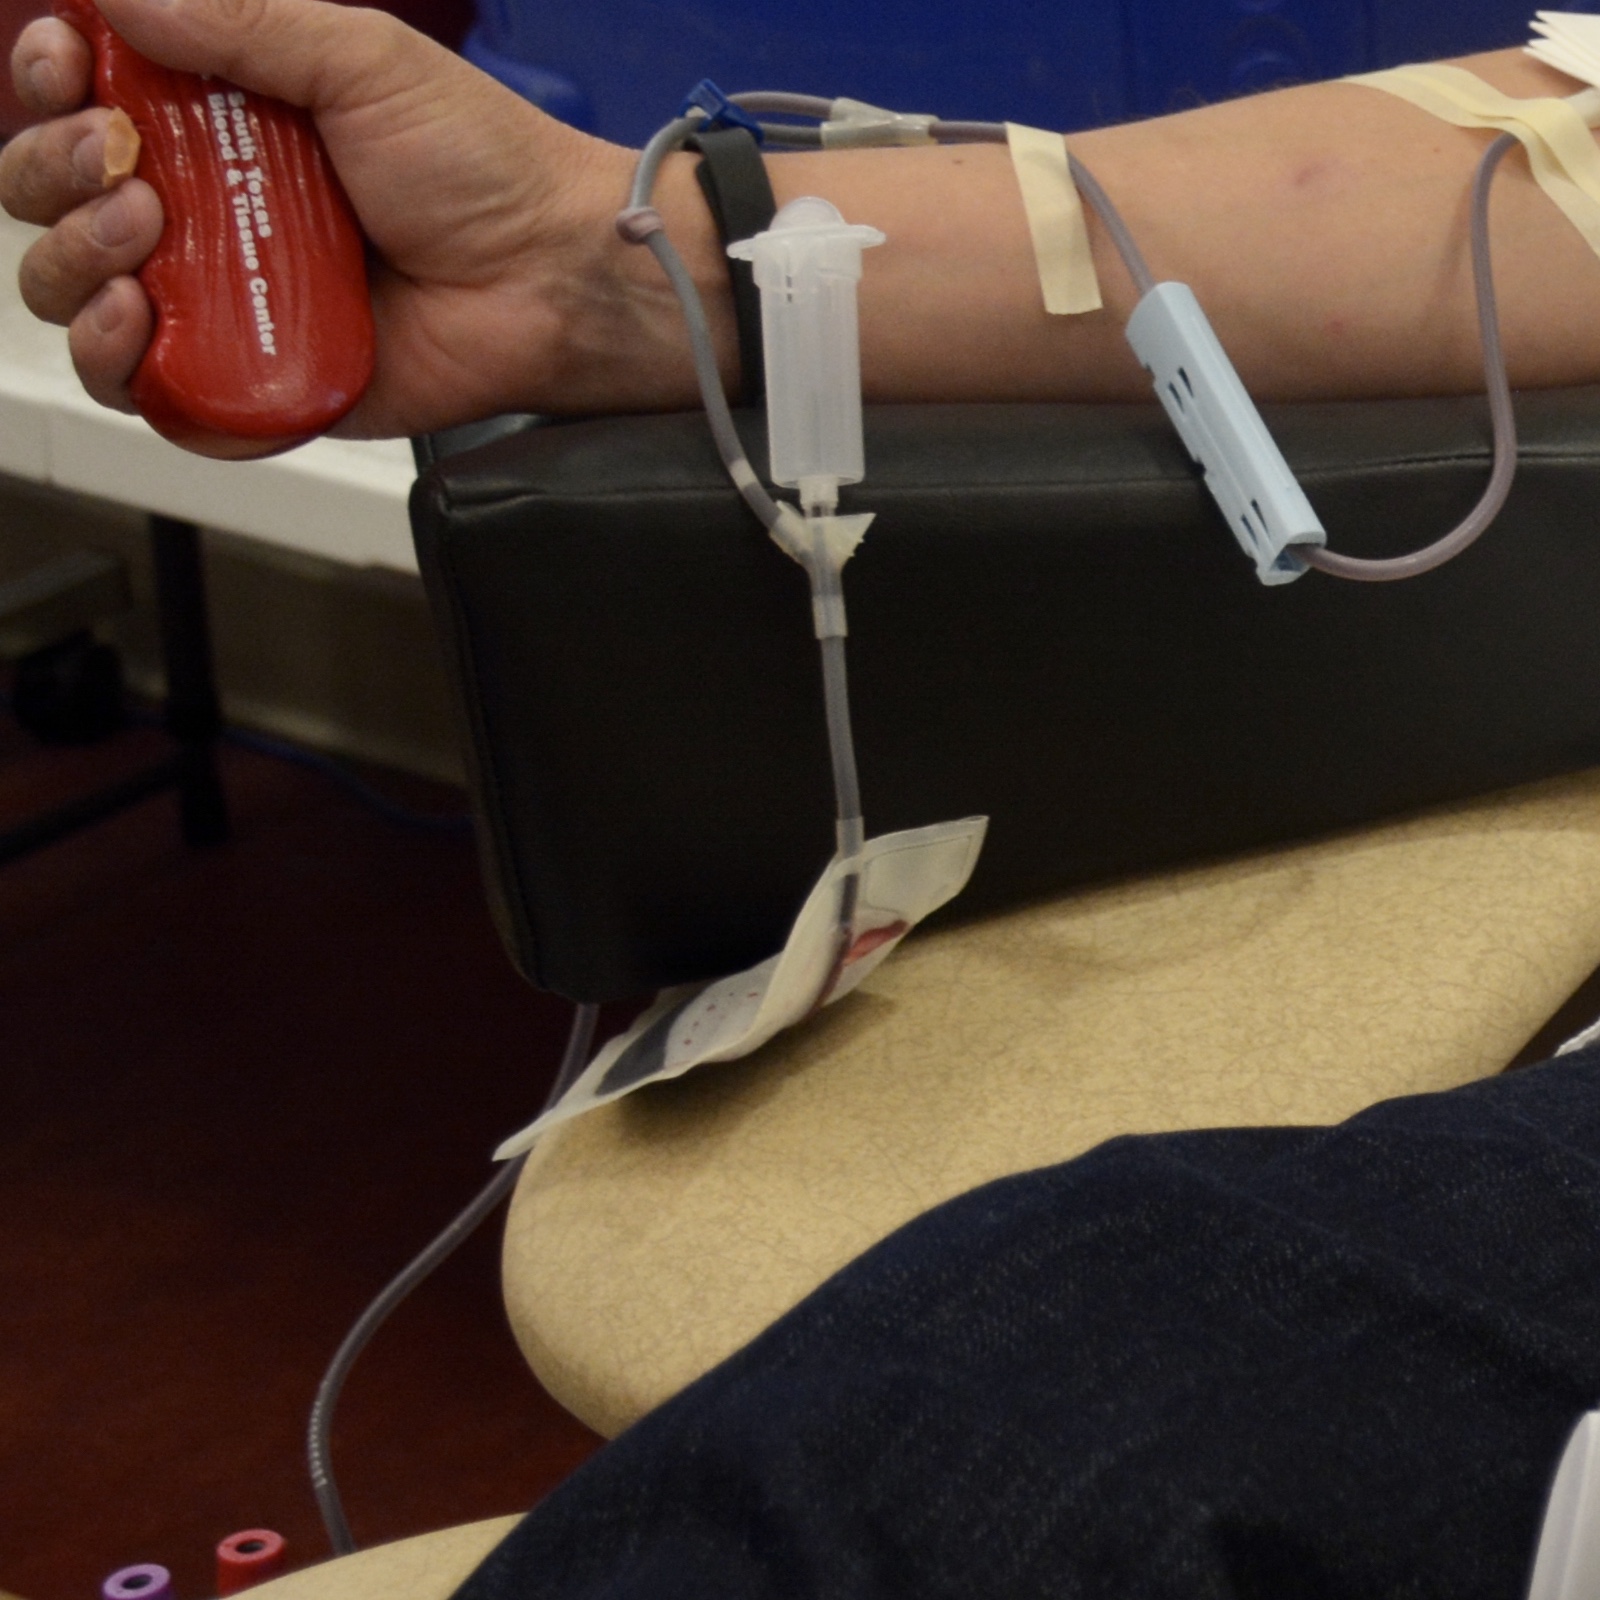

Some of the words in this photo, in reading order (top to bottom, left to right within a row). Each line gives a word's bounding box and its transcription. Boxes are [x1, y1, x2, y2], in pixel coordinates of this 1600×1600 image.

[208, 92, 239, 161] Blood
[228, 92, 257, 161] South
[245, 166, 272, 238] Texas
[226, 168, 243, 187] &
[232, 192, 260, 271] Tissue
[250, 277, 277, 356] Center
